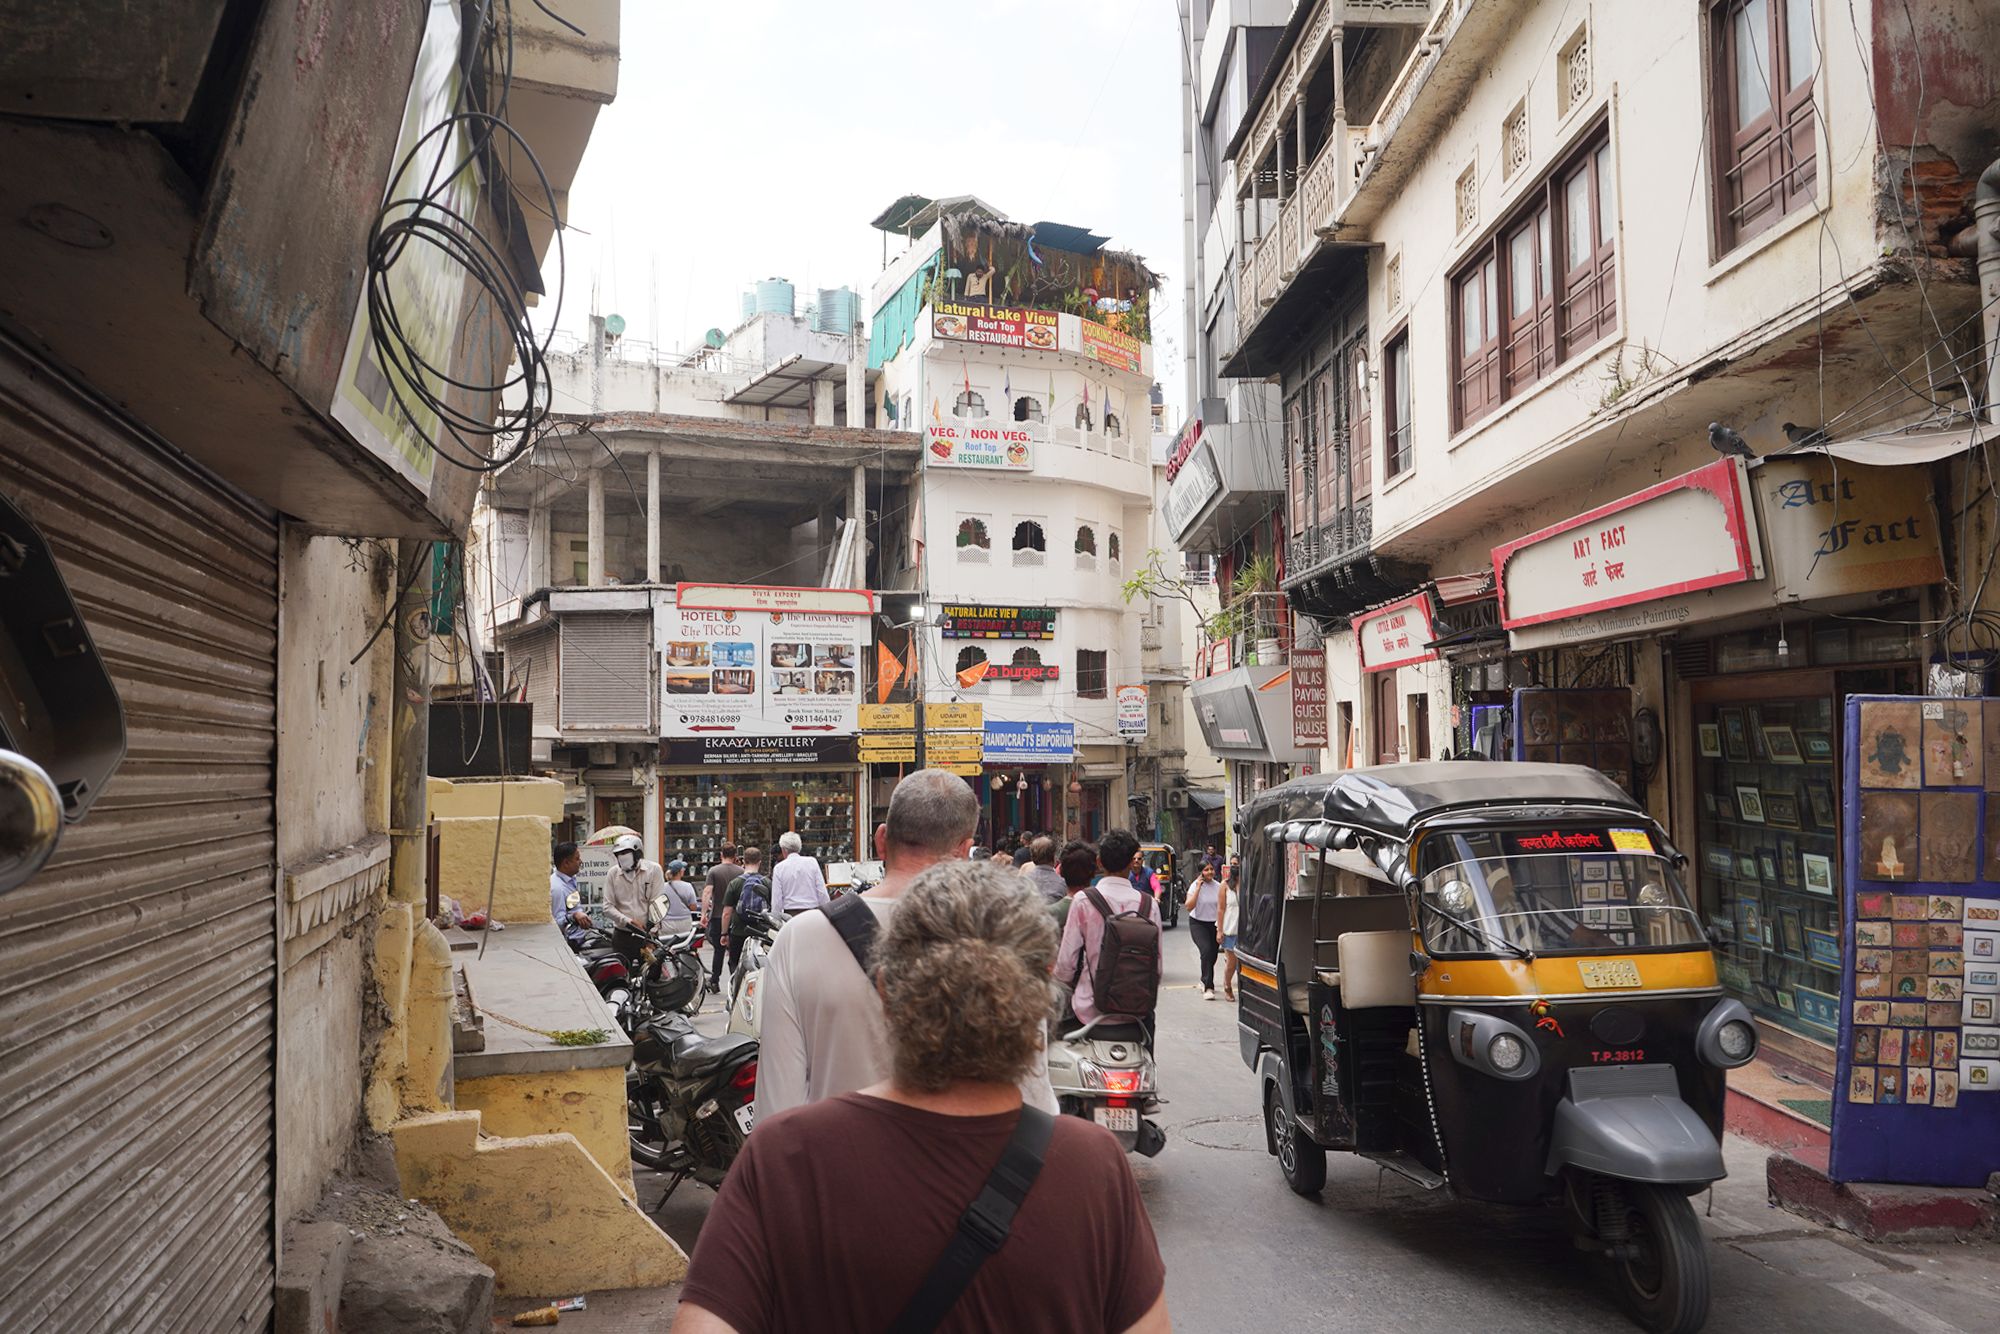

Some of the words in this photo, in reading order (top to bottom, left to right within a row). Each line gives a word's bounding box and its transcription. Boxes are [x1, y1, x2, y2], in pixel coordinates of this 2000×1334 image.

[934, 301, 985, 317] Natural
[989, 307, 1021, 321] Lake
[1025, 311, 1057, 326] View
[977, 319, 998, 330] Roof
[1000, 321, 1015, 332] Top
[969, 330, 1023, 346] RESTAURANT
[1082, 321, 1112, 344] COOKING
[1112, 332, 1139, 354] CLASSES
[930, 427, 959, 438] VEG.
[971, 429, 998, 440] NON
[1002, 431, 1031, 441] VEG.
[965, 441, 982, 452] Roof
[984, 443, 997, 454] Top
[958, 453, 1003, 465] RESTAURANT
[1779, 476, 1857, 510] Art
[1573, 537, 1591, 560] ART
[1600, 525, 1626, 551] FACT
[1813, 514, 1921, 557] Fact
[1582, 562, 1598, 588] आर्ट
[681, 611, 721, 621] HOTEL
[944, 606, 977, 618] NATURAL
[979, 608, 997, 618] LAKE
[1000, 608, 1018, 619] VIEW
[1558, 622, 1596, 639] Authentic
[1598, 613, 1641, 633] Miniature
[1642, 605, 1690, 625] Paintings
[703, 624, 741, 636] TIGER
[1002, 666, 1043, 680] burger
[1296, 671, 1322, 685] VILAS
[1294, 688, 1326, 702] PAYING
[1295, 704, 1326, 718] GUEST
[690, 715, 741, 723] 9784816989
[793, 715, 842, 723] 9811464147
[1118, 719, 1146, 728] RESTAURANT
[1296, 721, 1326, 735] HOUSE
[705, 738, 752, 748] EKAAYA
[755, 737, 816, 748] JEWELLERY
[985, 732, 1035, 747] HANDICRAFTS
[1036, 734, 1073, 748] EMPORIUM
